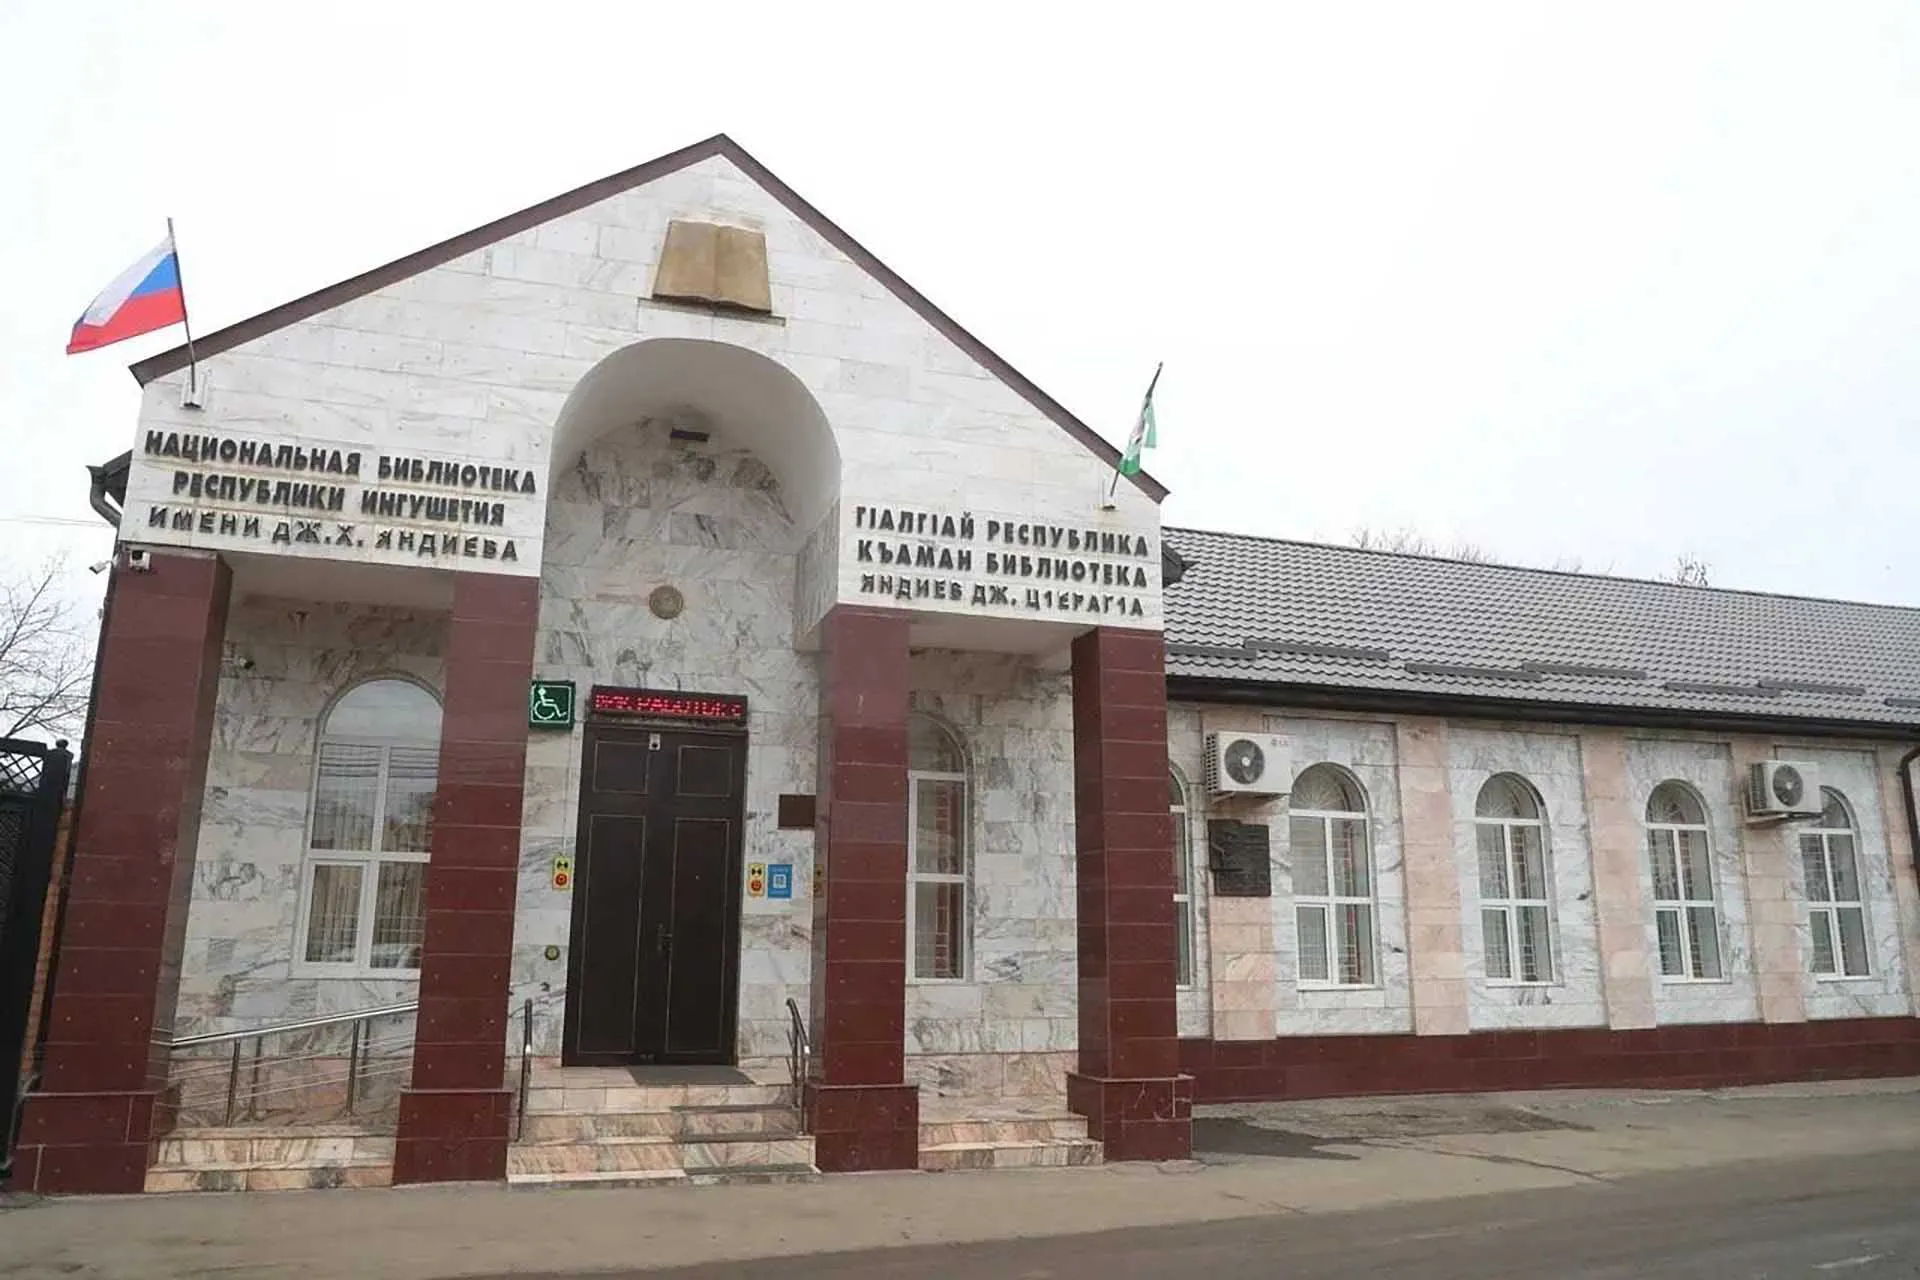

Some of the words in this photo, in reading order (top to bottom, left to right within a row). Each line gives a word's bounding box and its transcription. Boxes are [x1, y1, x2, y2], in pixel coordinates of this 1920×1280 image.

[144, 430, 361, 477] НАЦИОНАЛЬНАЯ
[378, 455, 536, 495] БИБЛИОТЕКА
[172, 470, 346, 512] РЕСПУБЛИКИ
[361, 489, 505, 527] ИНГУШЕТИЯ
[148, 506, 260, 539] ИМЕНИ
[374, 528, 518, 562] ЯНДИЕВА
[987, 520, 1149, 557] РЕСПУБЛИКА
[857, 539, 972, 572] КЪАМАН
[986, 552, 1148, 588] БИБЛИОТЕКА
[860, 573, 963, 602] ЯНДИЕВ
